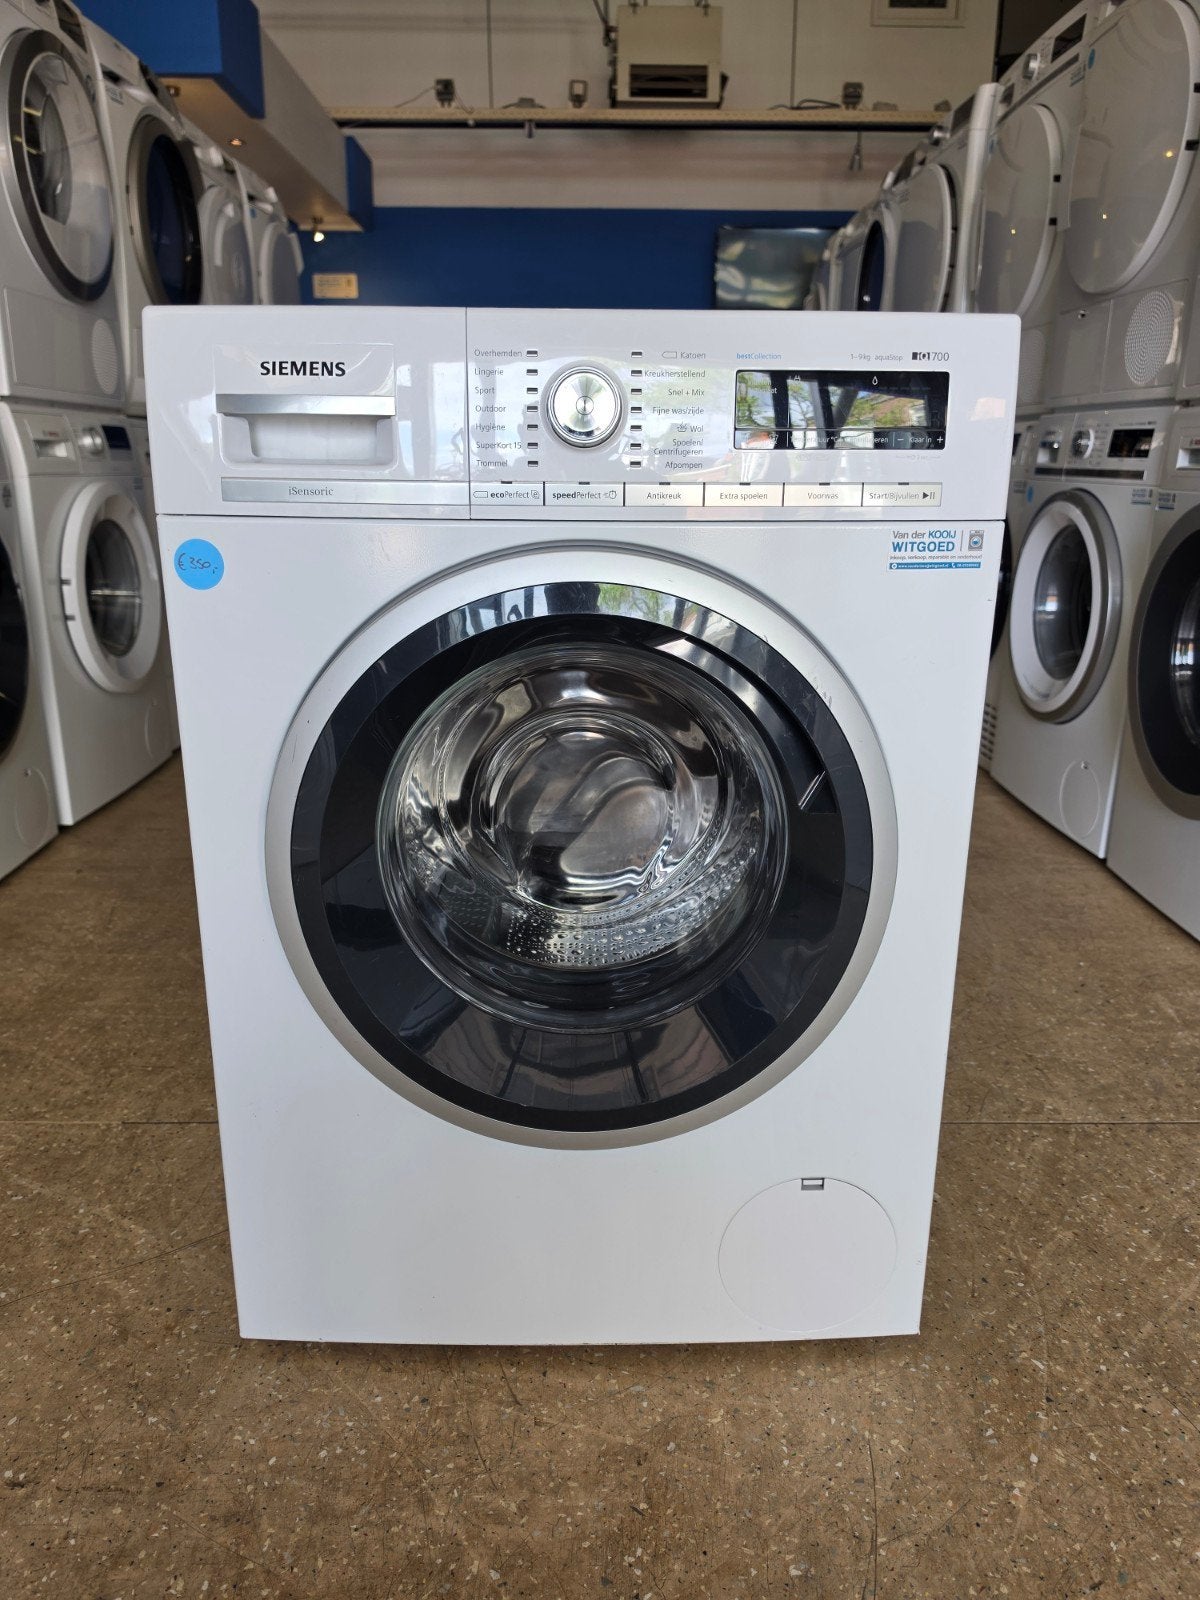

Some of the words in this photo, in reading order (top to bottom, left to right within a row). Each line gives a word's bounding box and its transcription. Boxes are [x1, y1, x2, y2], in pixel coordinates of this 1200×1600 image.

[473, 349, 523, 358] Overhemden
[680, 351, 706, 360] Katoen
[736, 352, 783, 361] bestCollection
[259, 360, 347, 378] SIEMENS
[474, 367, 504, 378] Lingerie
[644, 369, 706, 378] Kreukherstellend
[474, 386, 495, 396] Sport
[667, 388, 684, 396] Snel
[691, 388, 705, 397] Mix
[475, 404, 507, 413] Outdoor
[652, 406, 670, 416] Fijne
[689, 425, 704, 433] Wol
[476, 441, 513, 450] SuperKort
[514, 441, 522, 450] 15
[653, 447, 704, 458] Centrifugeren
[476, 459, 508, 467] Trommel
[664, 461, 703, 470] Afpompen
[288, 486, 335, 496] iSensoric
[490, 491, 530, 499] ecoPerfect
[552, 491, 601, 500] speedPerfect
[646, 492, 682, 500] Antikreuk
[719, 492, 739, 500] Extra
[739, 492, 768, 501] spoelen
[807, 492, 839, 500] Voorwas
[892, 530, 909, 539] Van
[911, 530, 926, 539] der
[928, 529, 957, 539] KOOIJ
[891, 541, 956, 553] WITGOED
